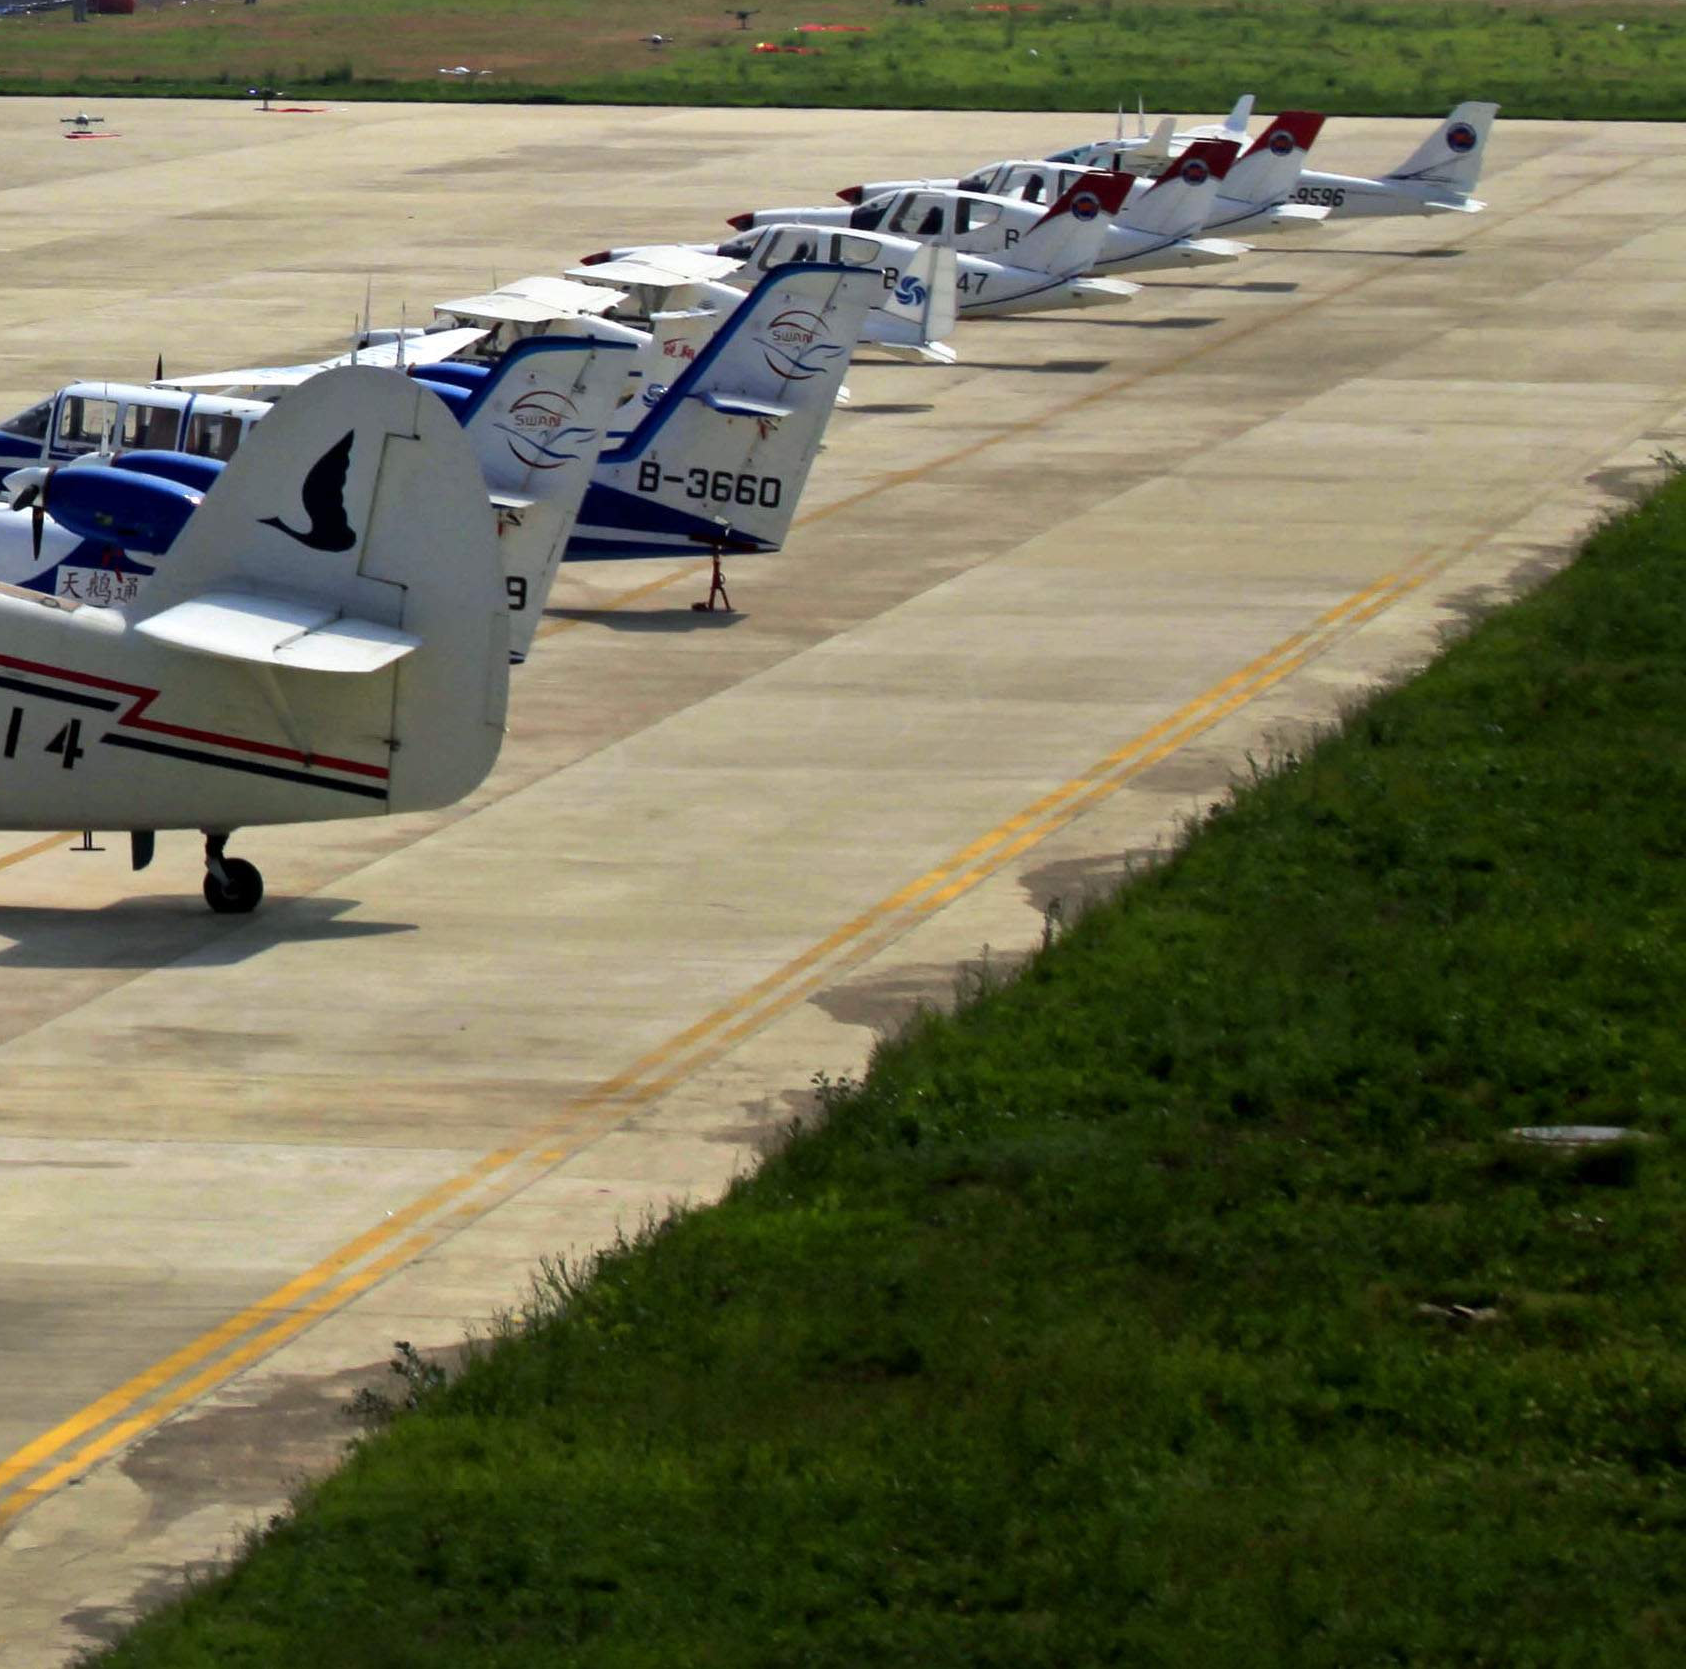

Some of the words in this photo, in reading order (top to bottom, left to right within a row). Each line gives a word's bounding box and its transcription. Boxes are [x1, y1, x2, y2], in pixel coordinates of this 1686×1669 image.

[771, 330, 814, 345] SWAN
[514, 414, 562, 428] SWAN
[637, 461, 783, 509] B-3660
[61, 571, 139, 604] 天鹅通
